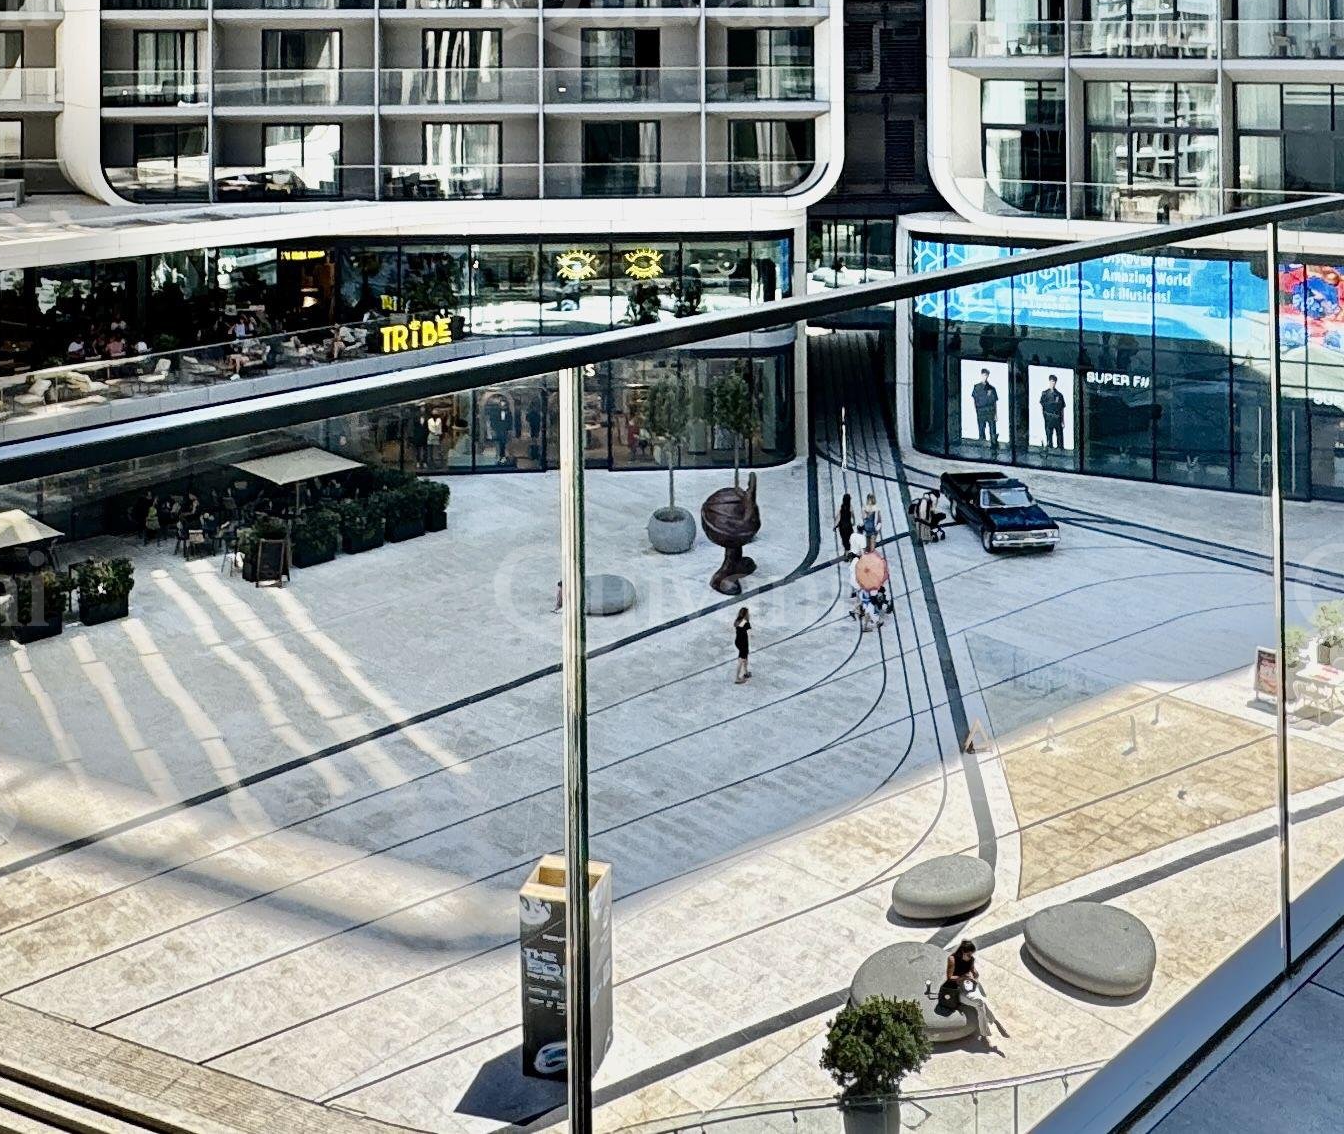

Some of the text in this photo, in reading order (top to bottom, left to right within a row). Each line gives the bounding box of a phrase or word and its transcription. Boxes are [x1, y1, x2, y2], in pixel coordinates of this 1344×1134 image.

[1102, 267, 1192, 288] Amazing World
[1103, 286, 1116, 300] of
[1086, 371, 1130, 387] SUPER
